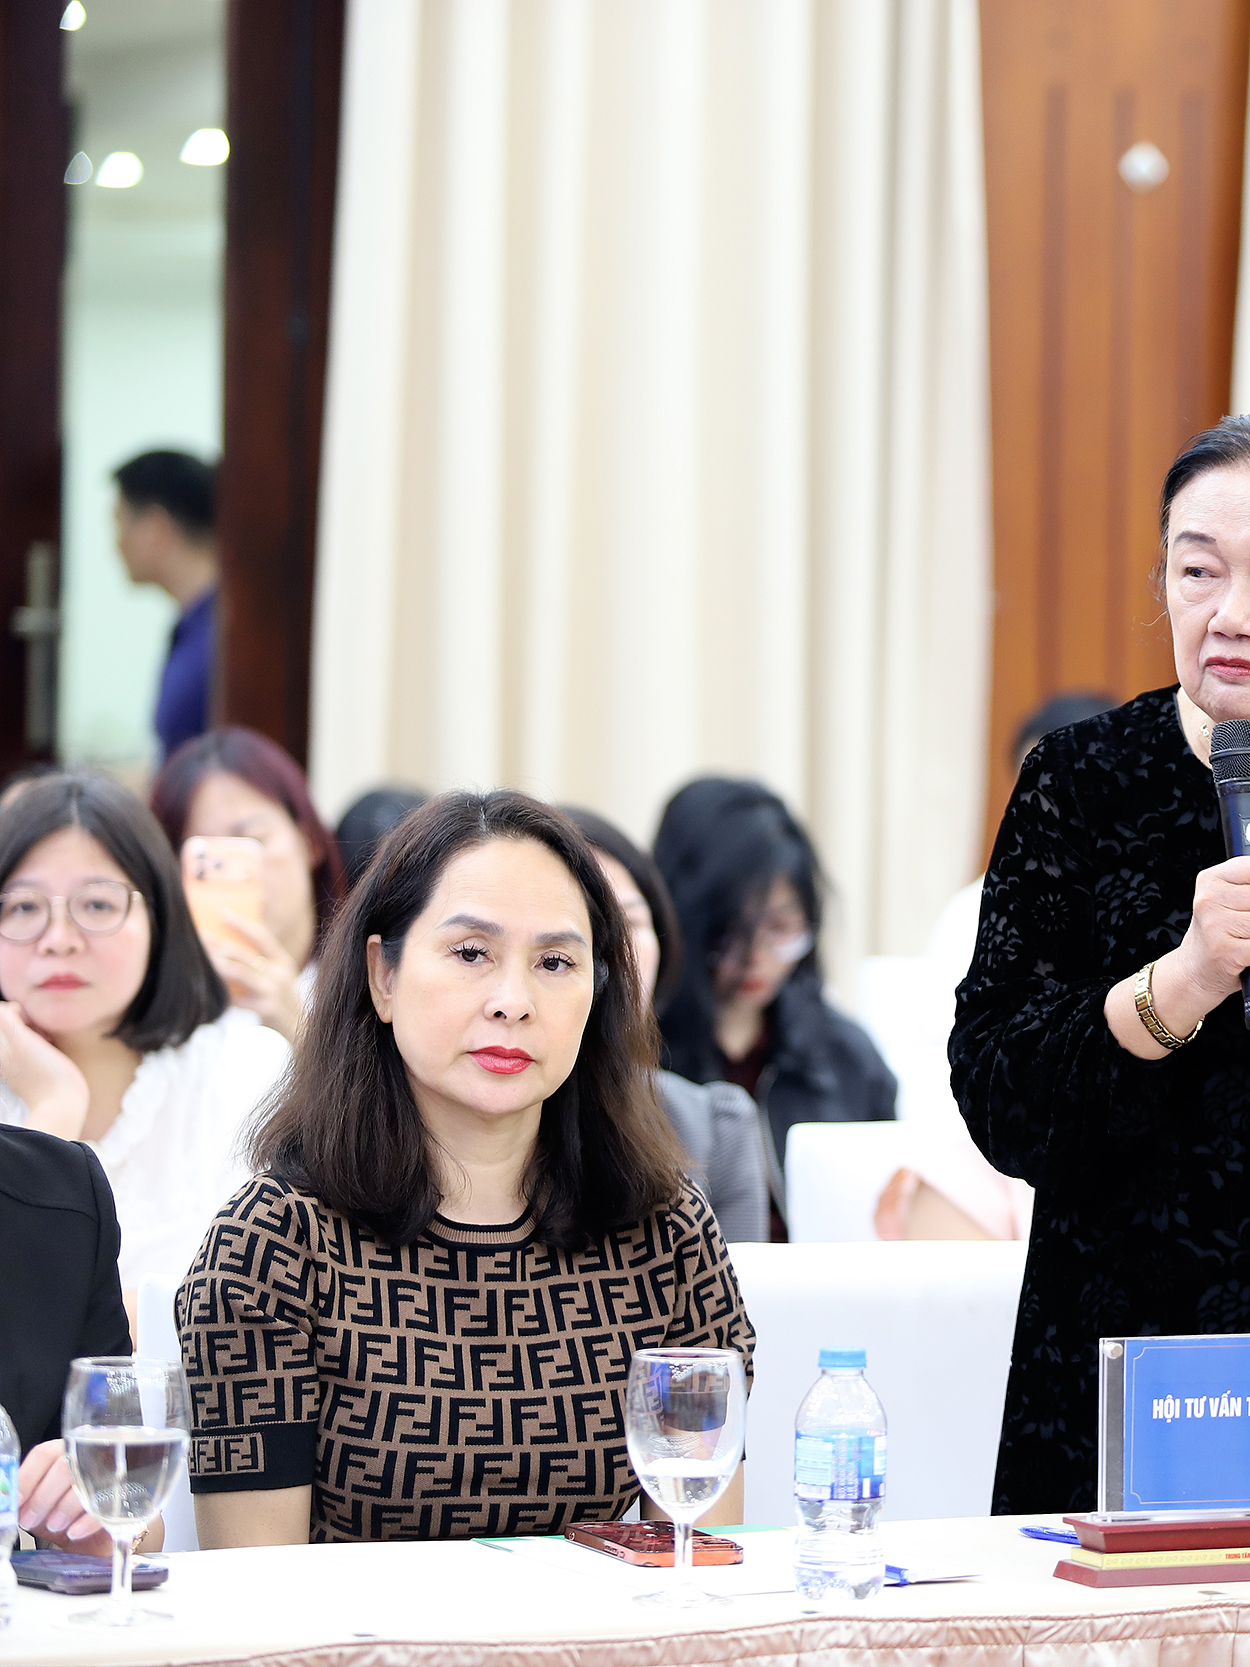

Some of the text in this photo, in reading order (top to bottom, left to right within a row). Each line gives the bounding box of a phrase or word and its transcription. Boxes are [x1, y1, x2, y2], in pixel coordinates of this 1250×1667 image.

[1152, 1394, 1180, 1423] HỘI
[1184, 1396, 1207, 1418] TƯ
[1209, 1389, 1242, 1418] VẤN
